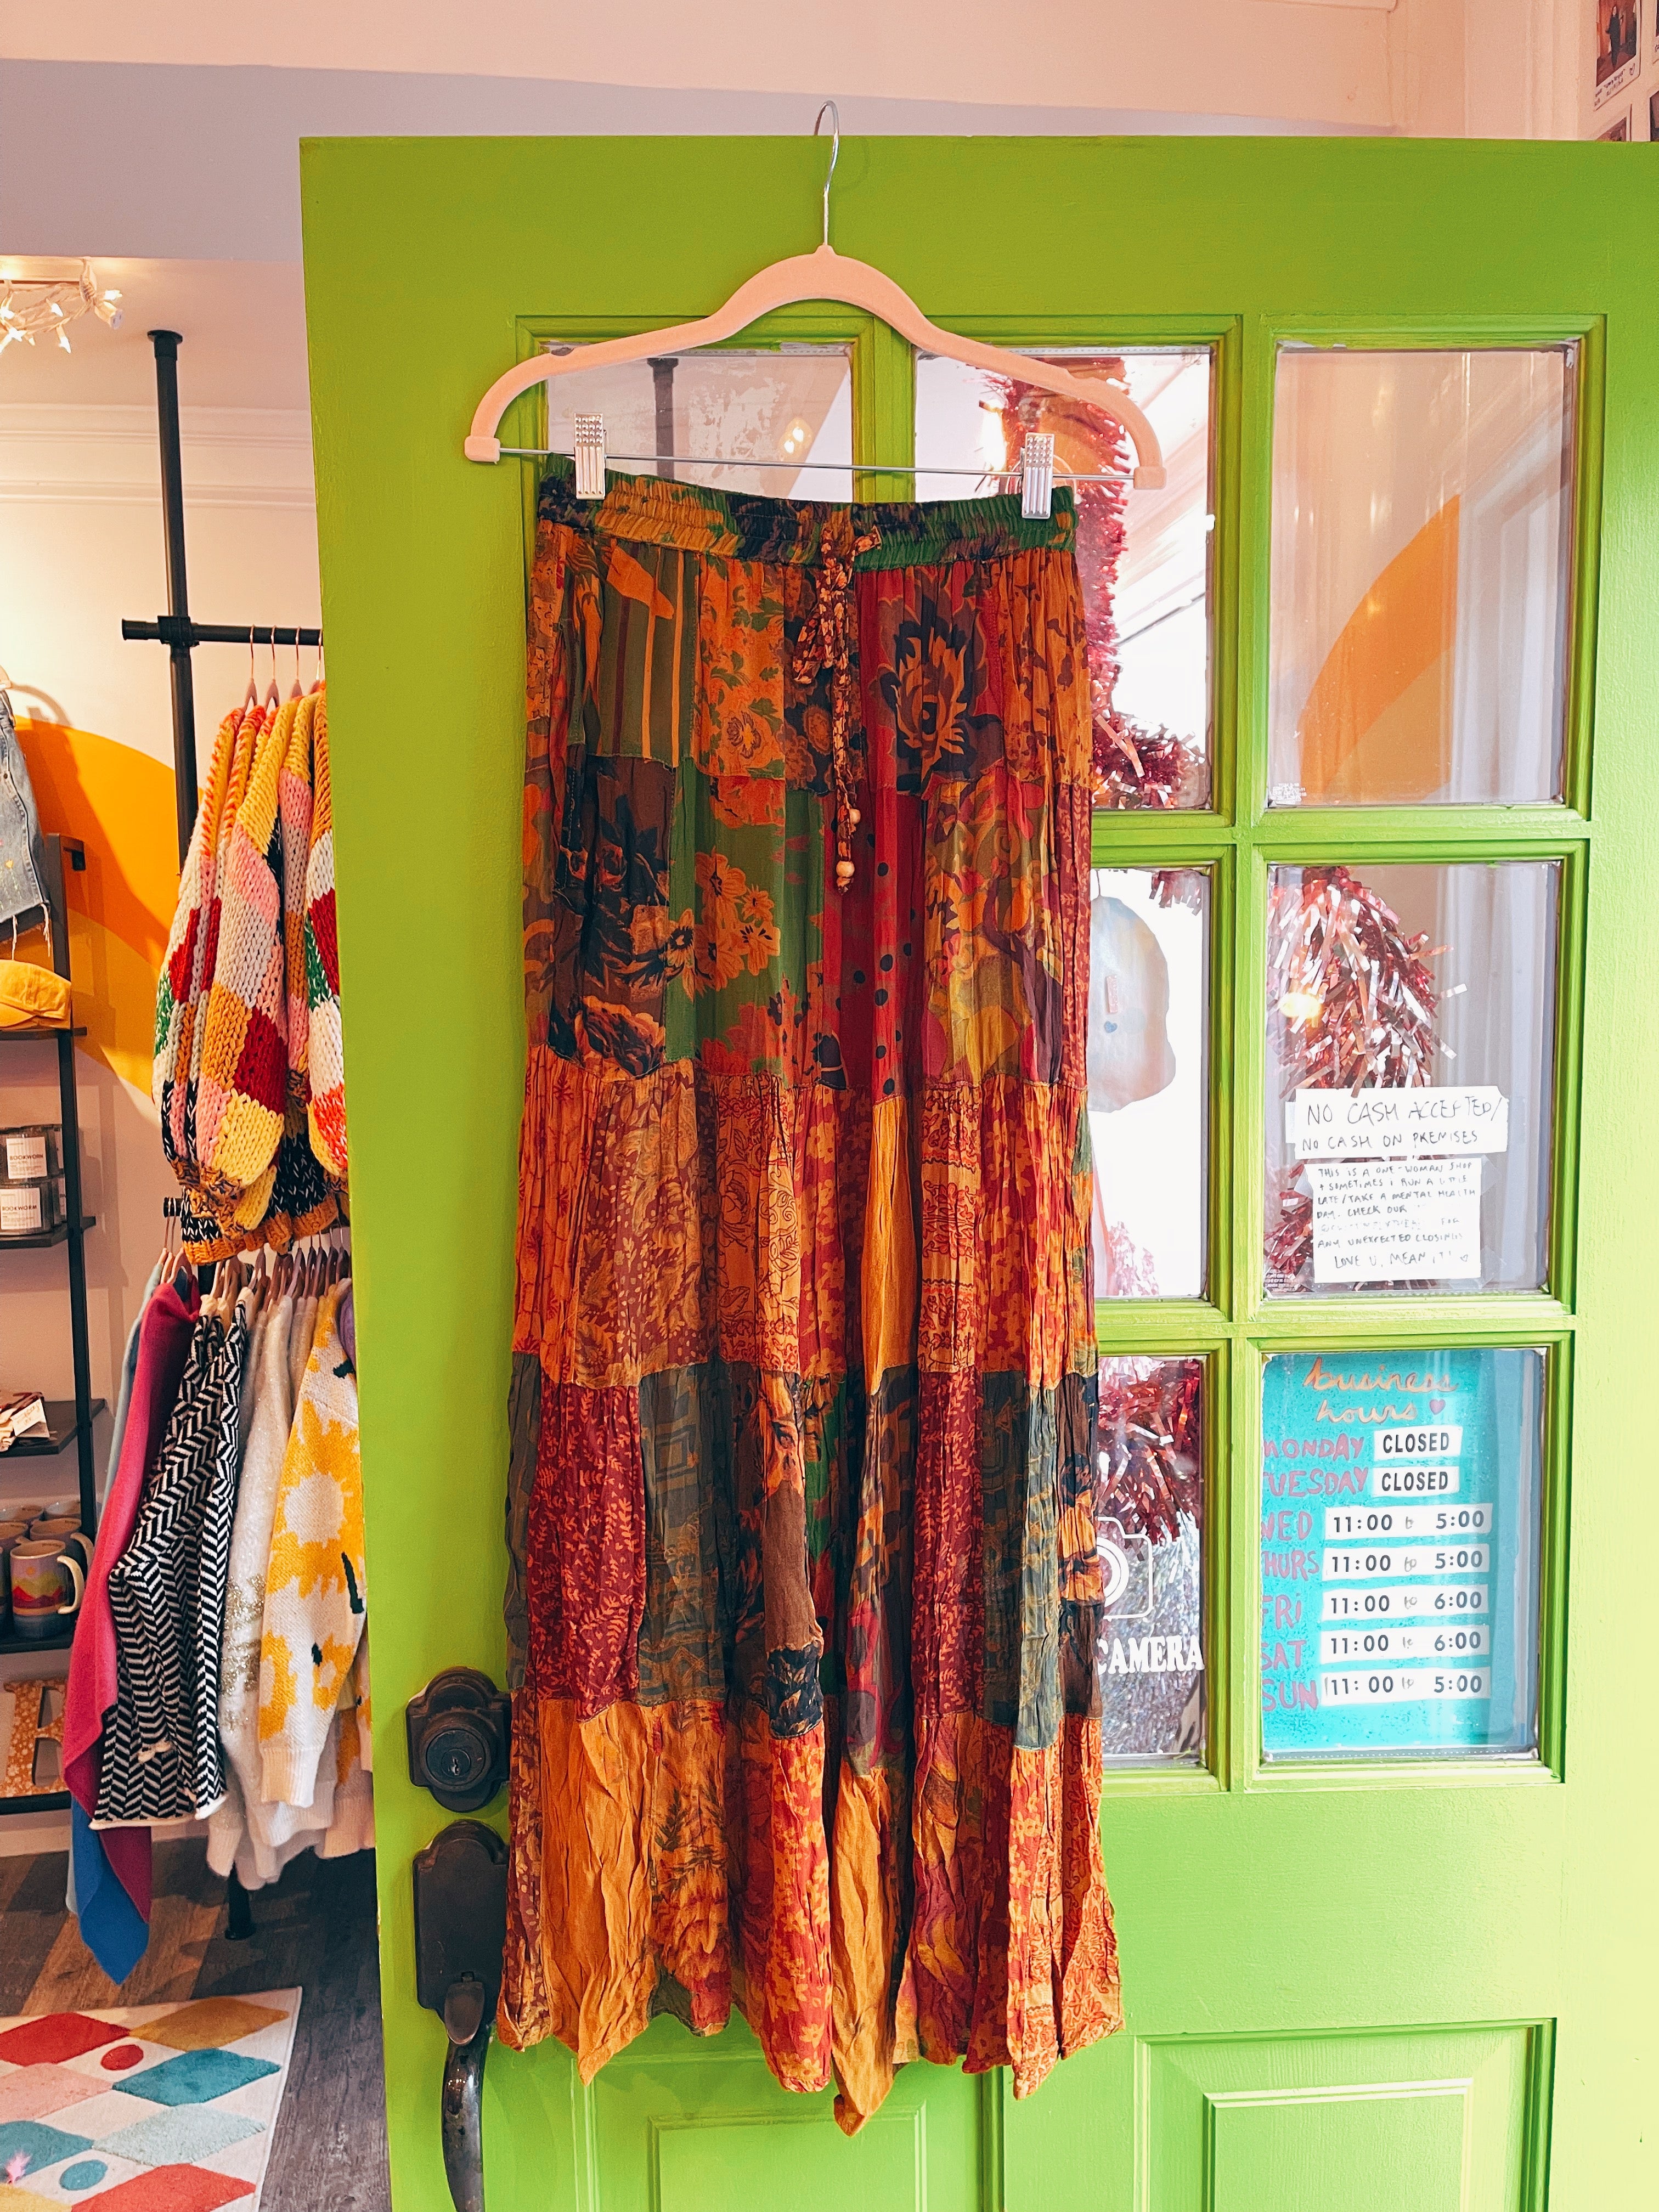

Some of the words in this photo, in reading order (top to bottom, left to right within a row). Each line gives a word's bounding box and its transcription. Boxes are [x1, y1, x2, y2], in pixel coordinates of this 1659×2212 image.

[1308, 1104, 1333, 1125] NO
[1347, 1102, 1399, 1126] CASH
[1302, 1138, 1318, 1151] NO
[1328, 1136, 1372, 1149] CASH
[1383, 1133, 1402, 1147] ON
[1363, 1169, 1370, 1177] A
[1401, 1178, 1420, 1186] RUN
[1347, 1205, 1380, 1217] CHECK
[1387, 1204, 1407, 1213] OUR
[1318, 1239, 1340, 1248] ANY
[1334, 1255, 1361, 1269] LOVE
[1390, 1251, 1426, 1265] MEAN
[1302, 1356, 1460, 1392] business
[1316, 1400, 1418, 1424] hours
[1263, 1433, 1364, 1462] MONDAY
[1383, 1432, 1449, 1453] CLOSED
[1381, 1471, 1448, 1491] CLOSED
[1334, 1514, 1392, 1532] 11:00
[1436, 1510, 1484, 1530] 5:00
[1332, 1555, 1391, 1572] 11:00
[1404, 1557, 1417, 1572] to
[1435, 1550, 1482, 1569] 5:00
[1331, 1595, 1390, 1614] 11:00
[1404, 1596, 1418, 1610] to
[1434, 1591, 1481, 1610] 6:00
[1331, 1634, 1389, 1654] 11:00
[1434, 1632, 1481, 1651] 6:00
[1262, 1678, 1319, 1711] SUN
[1434, 1675, 1482, 1693] 5:00
